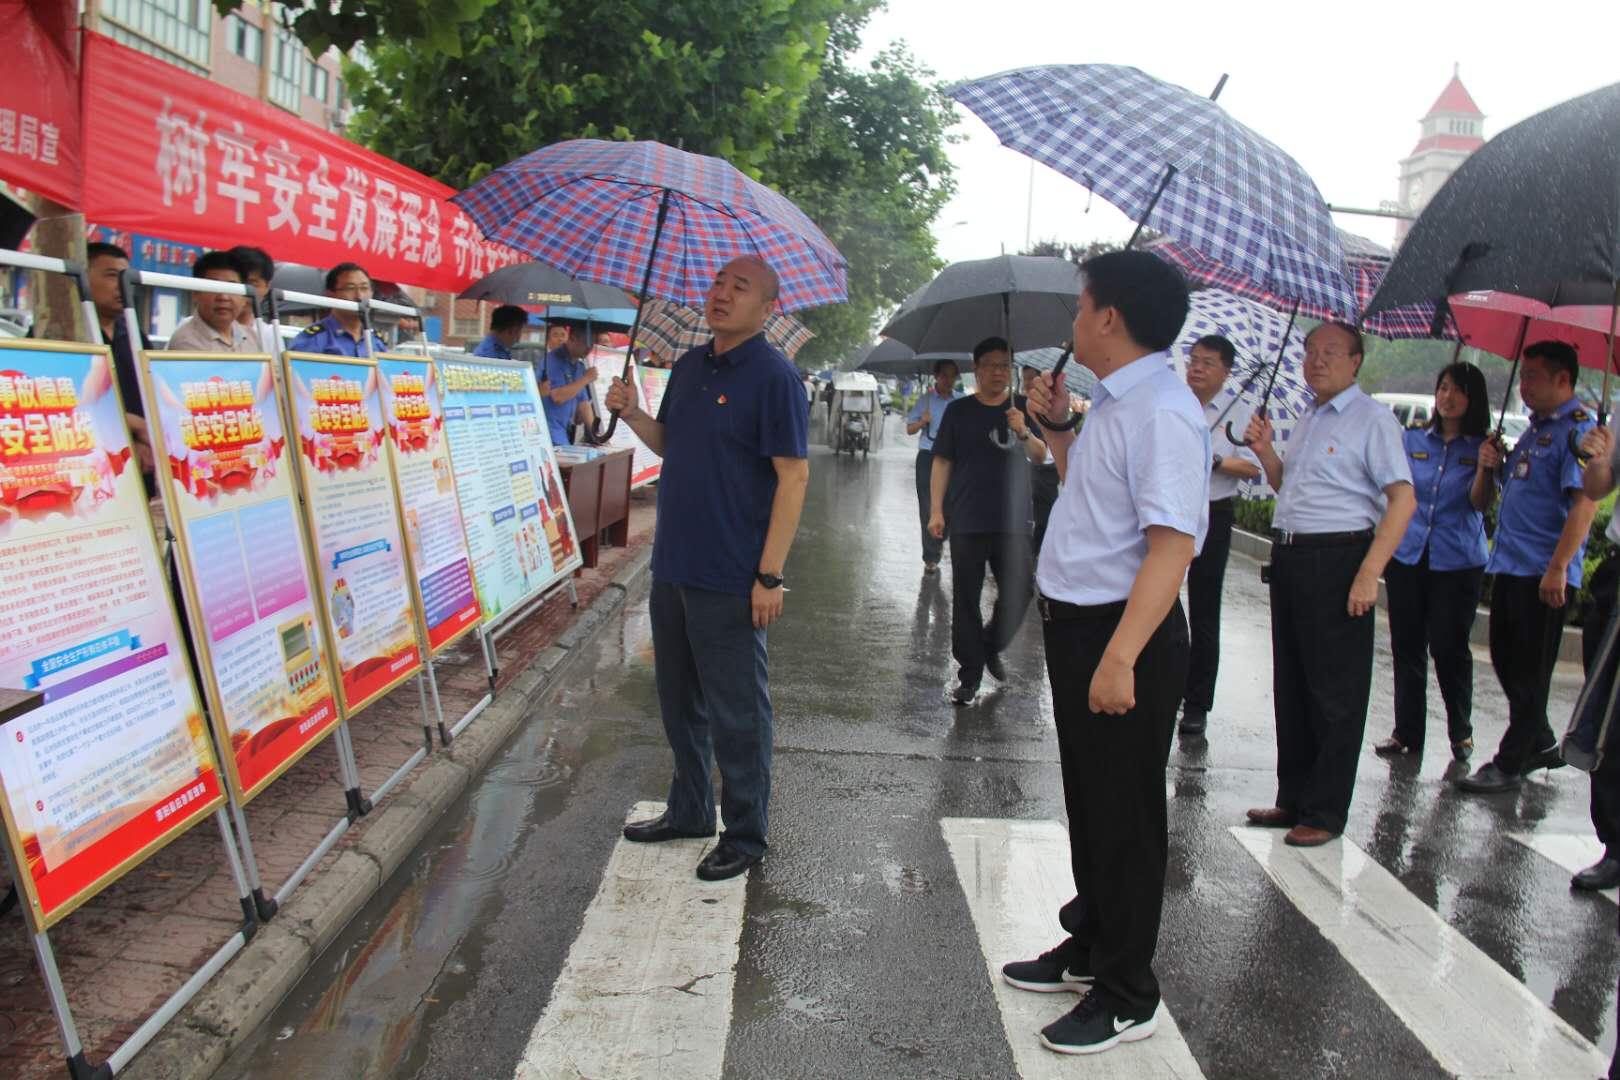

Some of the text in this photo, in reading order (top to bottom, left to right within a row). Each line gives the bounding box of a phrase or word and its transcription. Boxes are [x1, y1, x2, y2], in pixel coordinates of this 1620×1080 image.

[156, 97, 442, 268] 树牢安全发展理念
